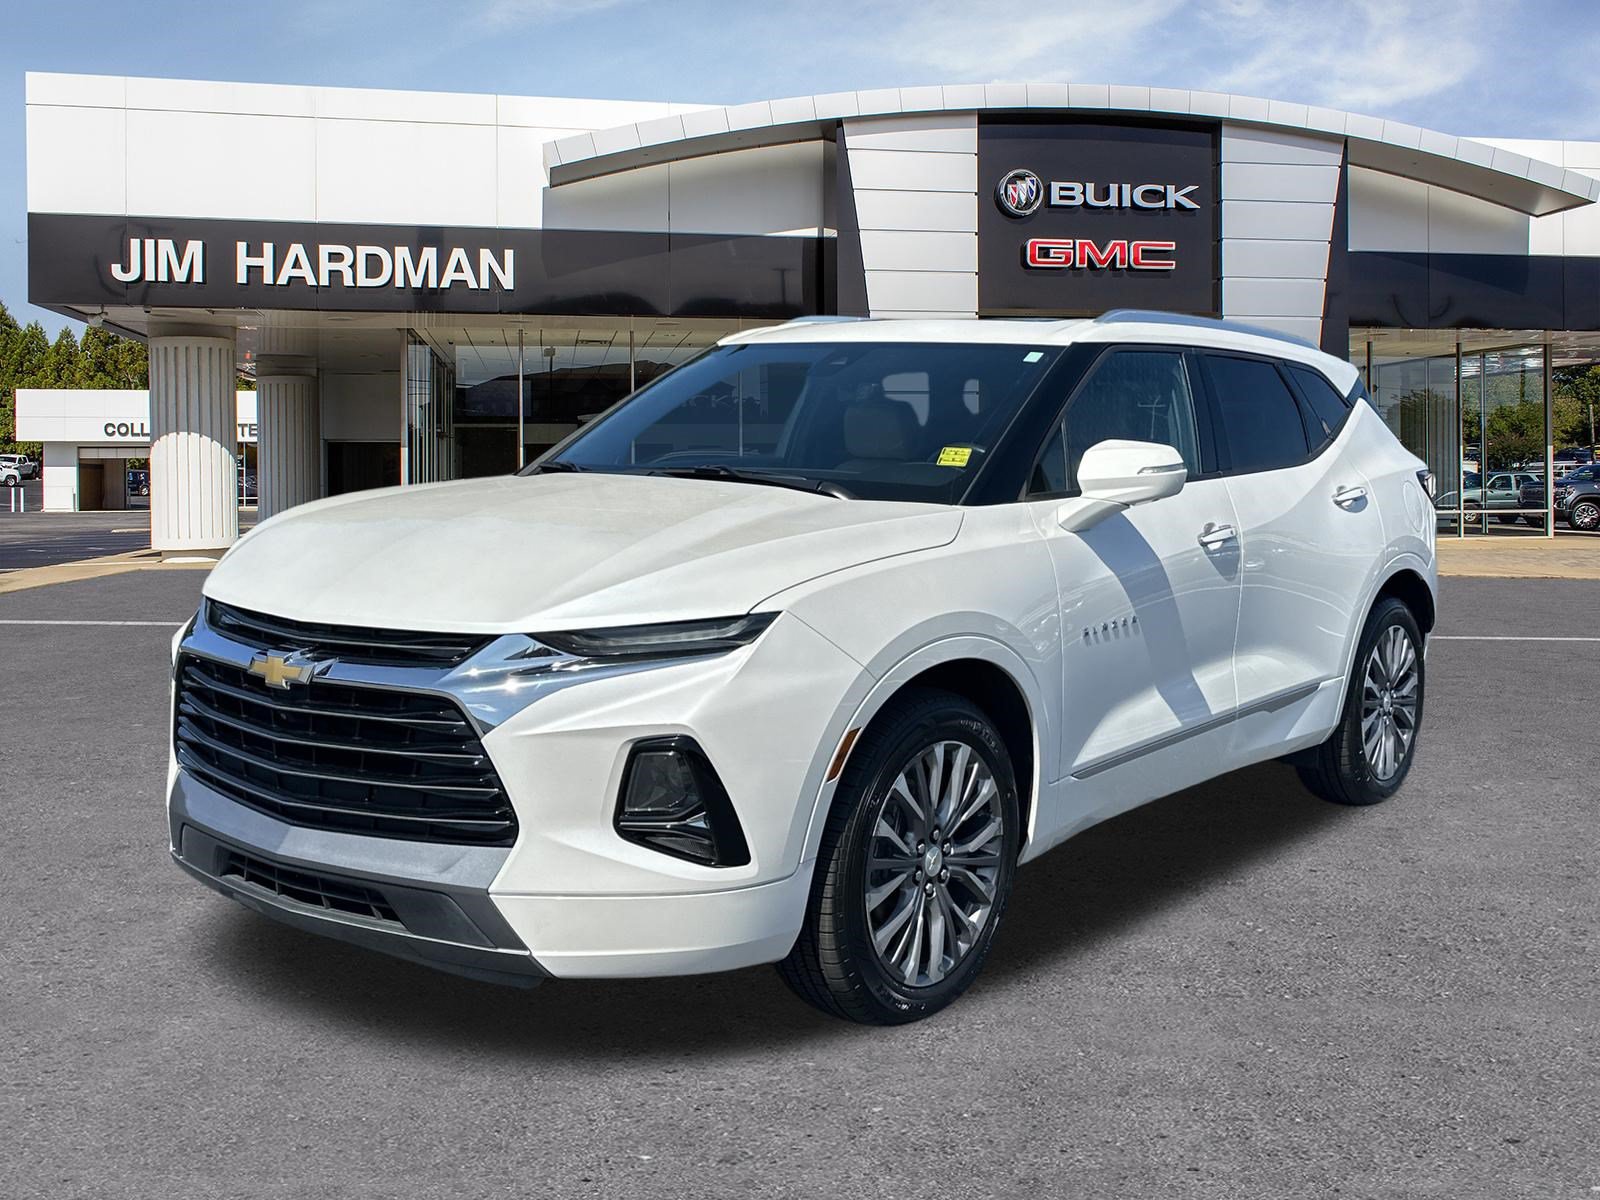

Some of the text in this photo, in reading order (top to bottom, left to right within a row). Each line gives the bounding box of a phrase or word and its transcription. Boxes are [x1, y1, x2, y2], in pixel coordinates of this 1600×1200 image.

[1050, 181, 1200, 209] BUICK
[110, 238, 515, 291] JIM HARDMAN
[1026, 238, 1176, 270] GMC
